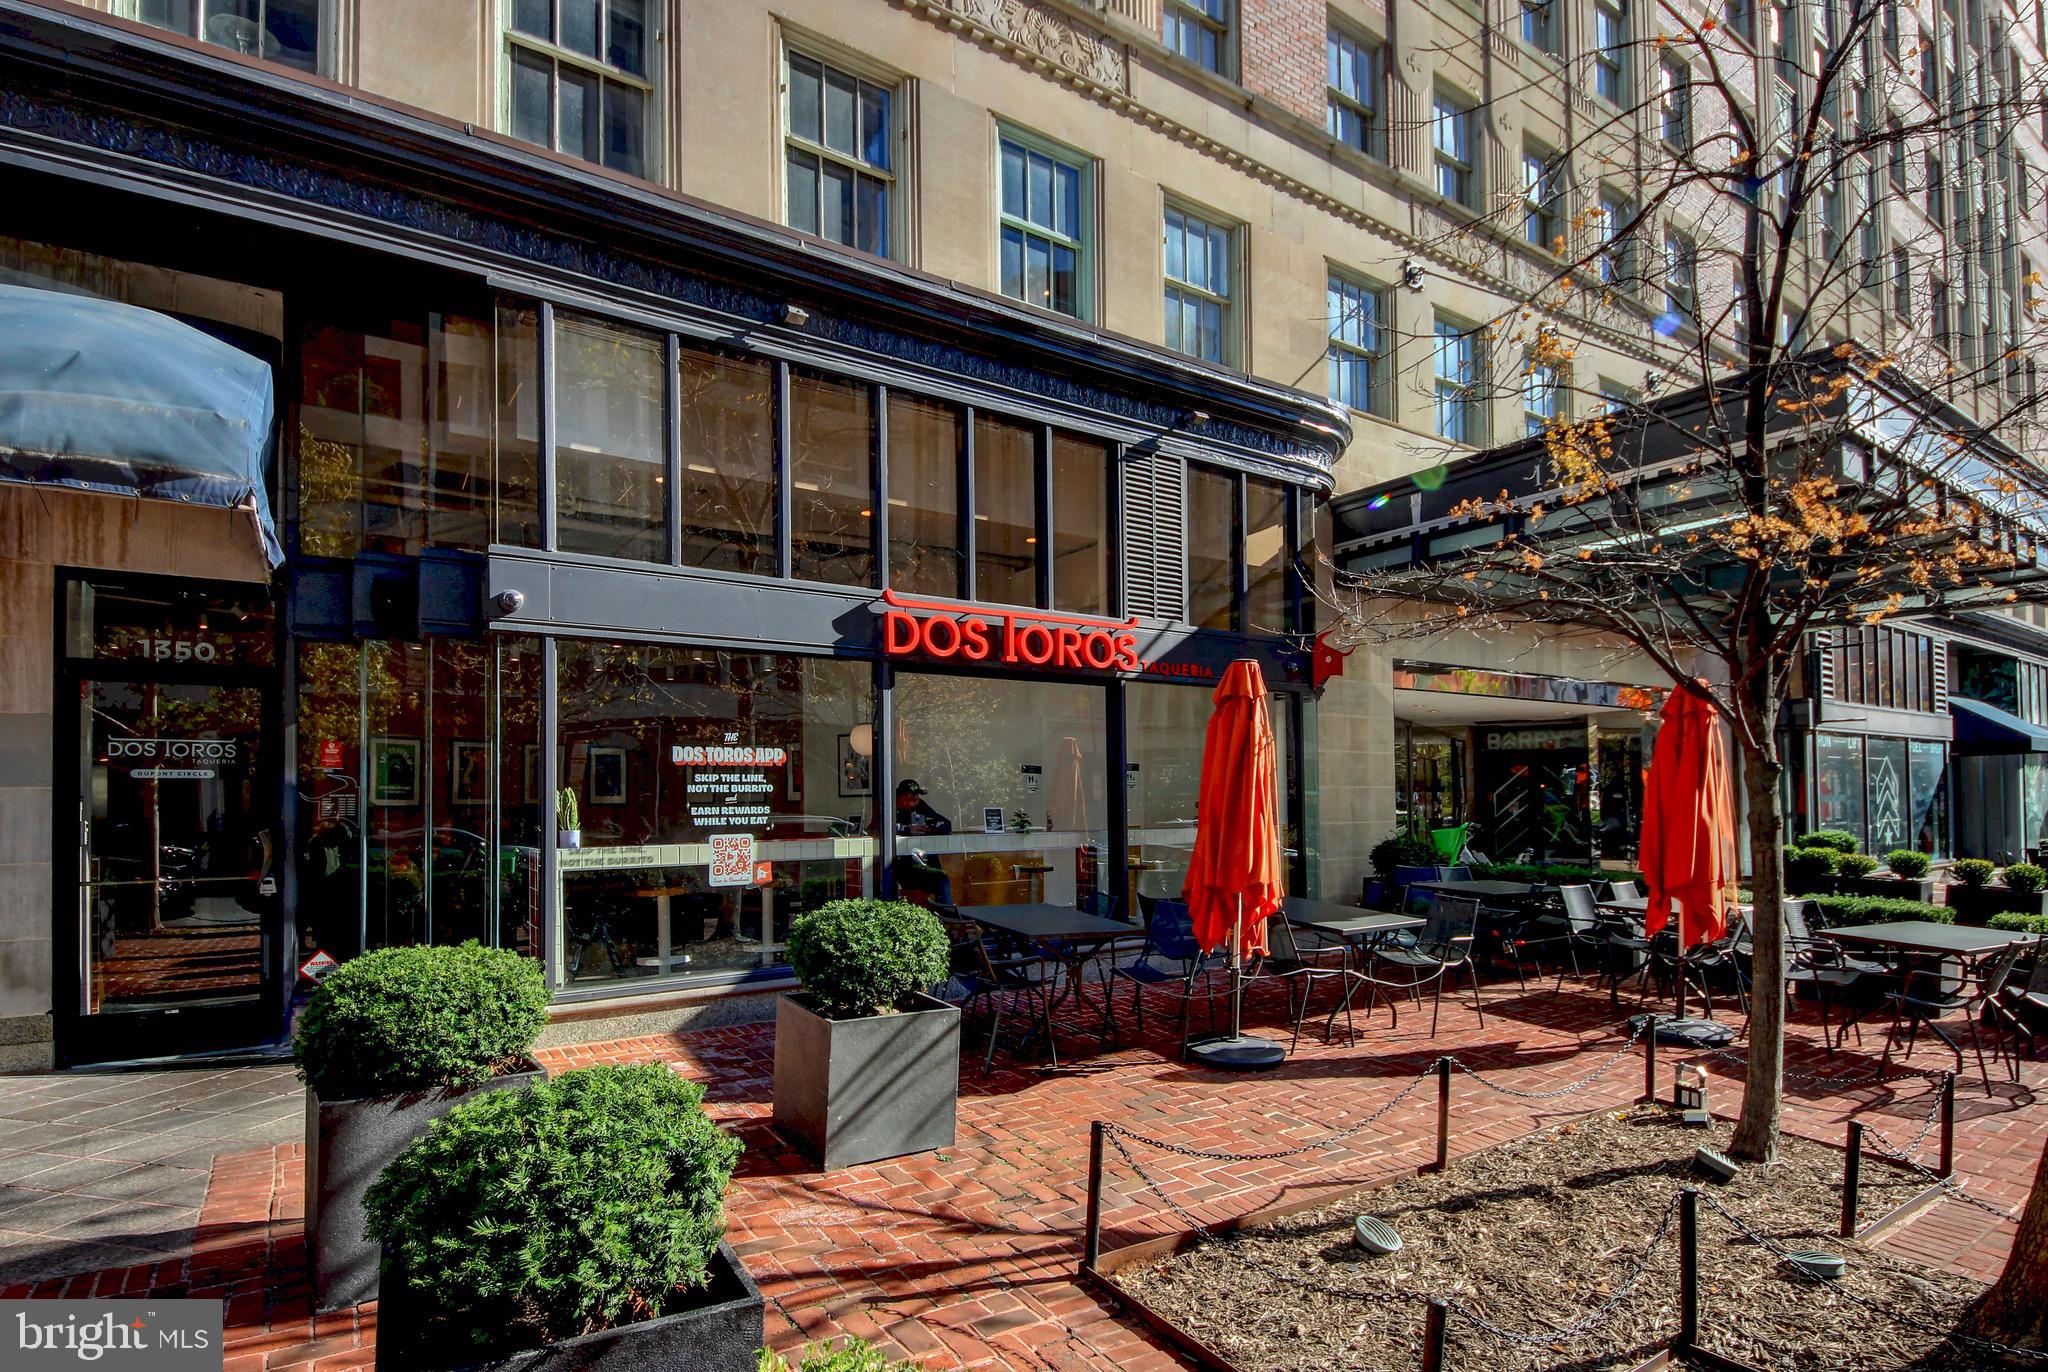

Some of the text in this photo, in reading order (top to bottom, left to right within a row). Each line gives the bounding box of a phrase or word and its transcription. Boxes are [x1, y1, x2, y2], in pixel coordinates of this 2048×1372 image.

[884, 610, 1140, 671] DOS TOROS
[137, 639, 216, 661] 1350
[1141, 660, 1214, 678] TAQUERIA
[724, 732, 739, 742] THE
[108, 739, 237, 758] DOS TOROS
[672, 746, 787, 766] DOS TOROS APP
[694, 774, 767, 784] SKIP THE LINE,
[687, 784, 774, 793] NOT THE BURRITO
[725, 794, 738, 802] and
[691, 806, 771, 816] EARN REWARDS
[693, 816, 768, 826] WHILE YOU EAT
